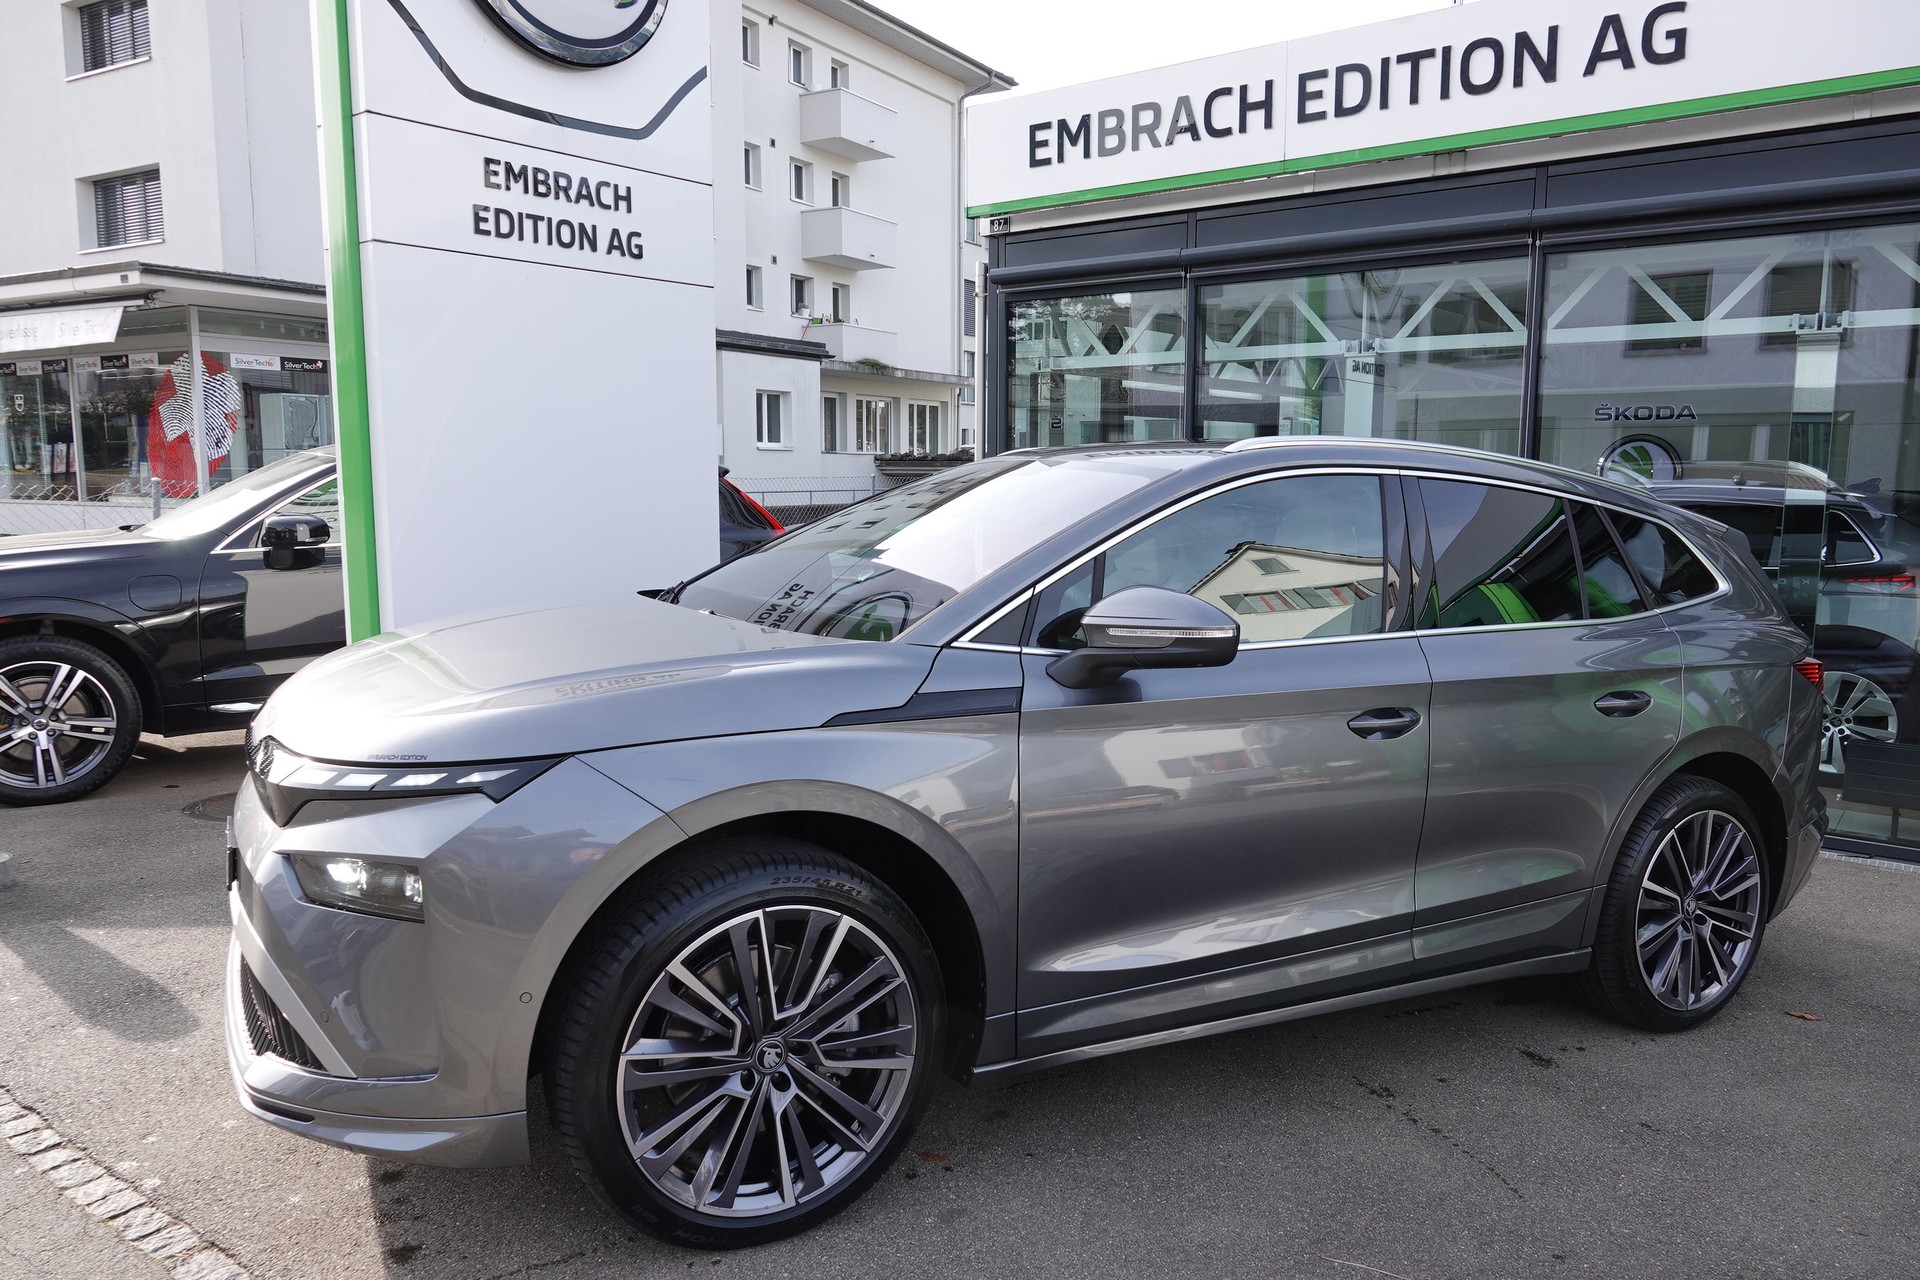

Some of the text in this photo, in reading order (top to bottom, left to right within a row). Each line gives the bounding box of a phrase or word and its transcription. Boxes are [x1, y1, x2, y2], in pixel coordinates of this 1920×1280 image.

[1028, 1, 1688, 169] EMBRACH EDITION AG
[483, 156, 632, 214] EMBRACH
[472, 203, 644, 260] EDITION AG
[993, 219, 1005, 232] 87
[284, 360, 319, 370] SilverTech
[1594, 403, 1698, 421] ŠKODA
